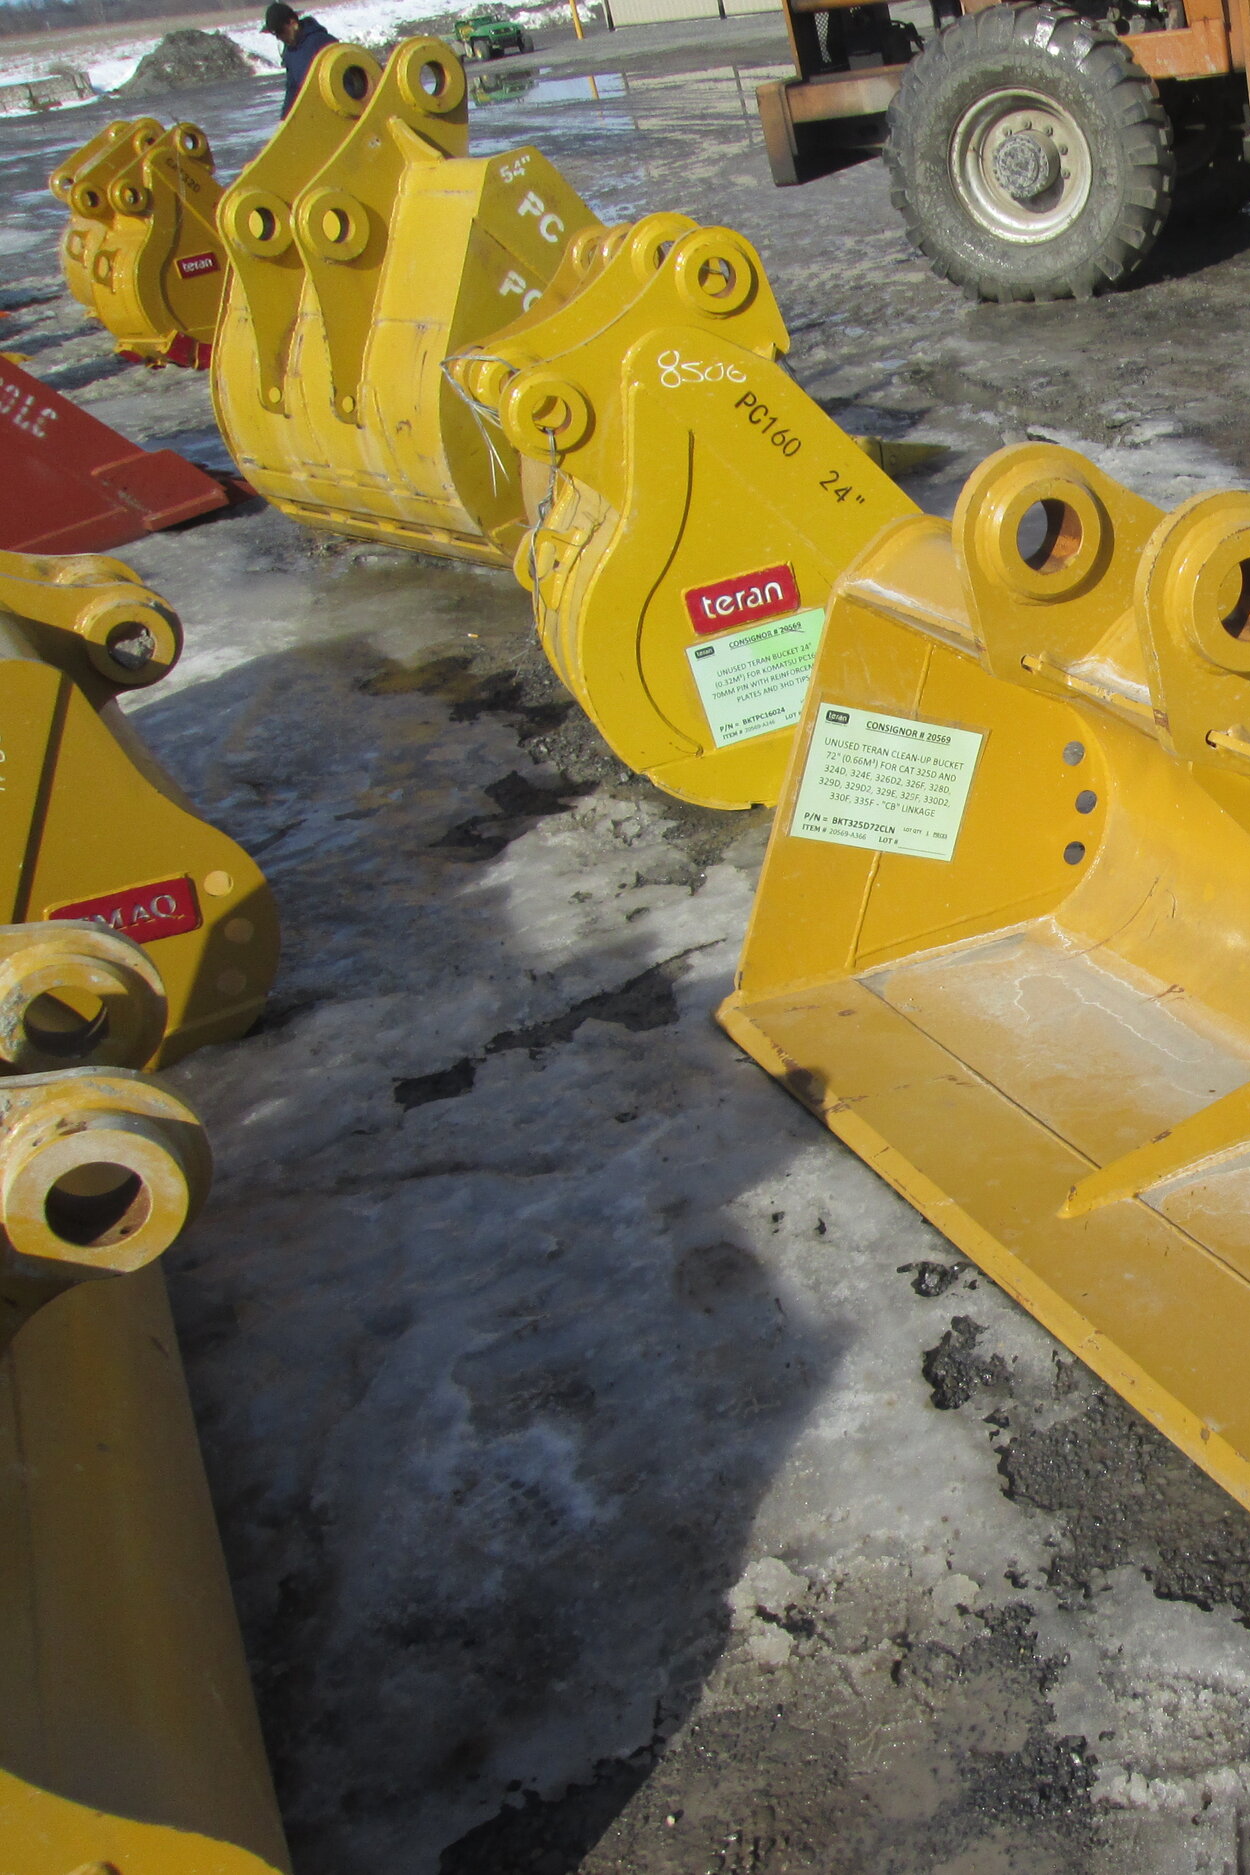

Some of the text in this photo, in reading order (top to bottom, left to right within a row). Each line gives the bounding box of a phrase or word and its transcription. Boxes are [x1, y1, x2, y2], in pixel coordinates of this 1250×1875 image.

[517, 190, 565, 243] PC
[182, 257, 214, 273] teran
[657, 350, 747, 388] 8506
[734, 390, 866, 504] PC160 24"
[702, 581, 784, 619] teran
[729, 630, 772, 648] CONSIGNOR
[780, 621, 802, 634] 20569
[717, 663, 747, 677] UNUSED
[748, 655, 771, 668] TERAN
[772, 647, 799, 660] BUCKET
[746, 670, 762, 679] FOR
[762, 659, 798, 674] KOMATSU
[736, 684, 749, 693] PIN
[751, 676, 770, 688] WITH
[736, 690, 762, 703] PLATES
[763, 684, 779, 694] AND
[719, 722, 734, 733] P/N
[722, 731, 738, 740] ITEM
[785, 712, 797, 721] LOT
[866, 720, 918, 738] CONSIGNOR
[926, 732, 952, 744] 20569
[824, 737, 964, 771] UNUSED TERAN CLEAN-UP BUCKET
[880, 761, 897, 772] FOR
[898, 765, 915, 775] CAT
[916, 767, 937, 779] 325D
[938, 772, 957, 783] AND
[854, 795, 875, 807] 335F
[882, 800, 901, 811] "CB"
[901, 805, 936, 818] LINKAGE
[802, 823, 821, 832] ITEM
[804, 812, 821, 822] P/N
[831, 816, 896, 834] BKT325D72CLN
[878, 836, 895, 845] LOT
[81, 893, 180, 930] MAQ
